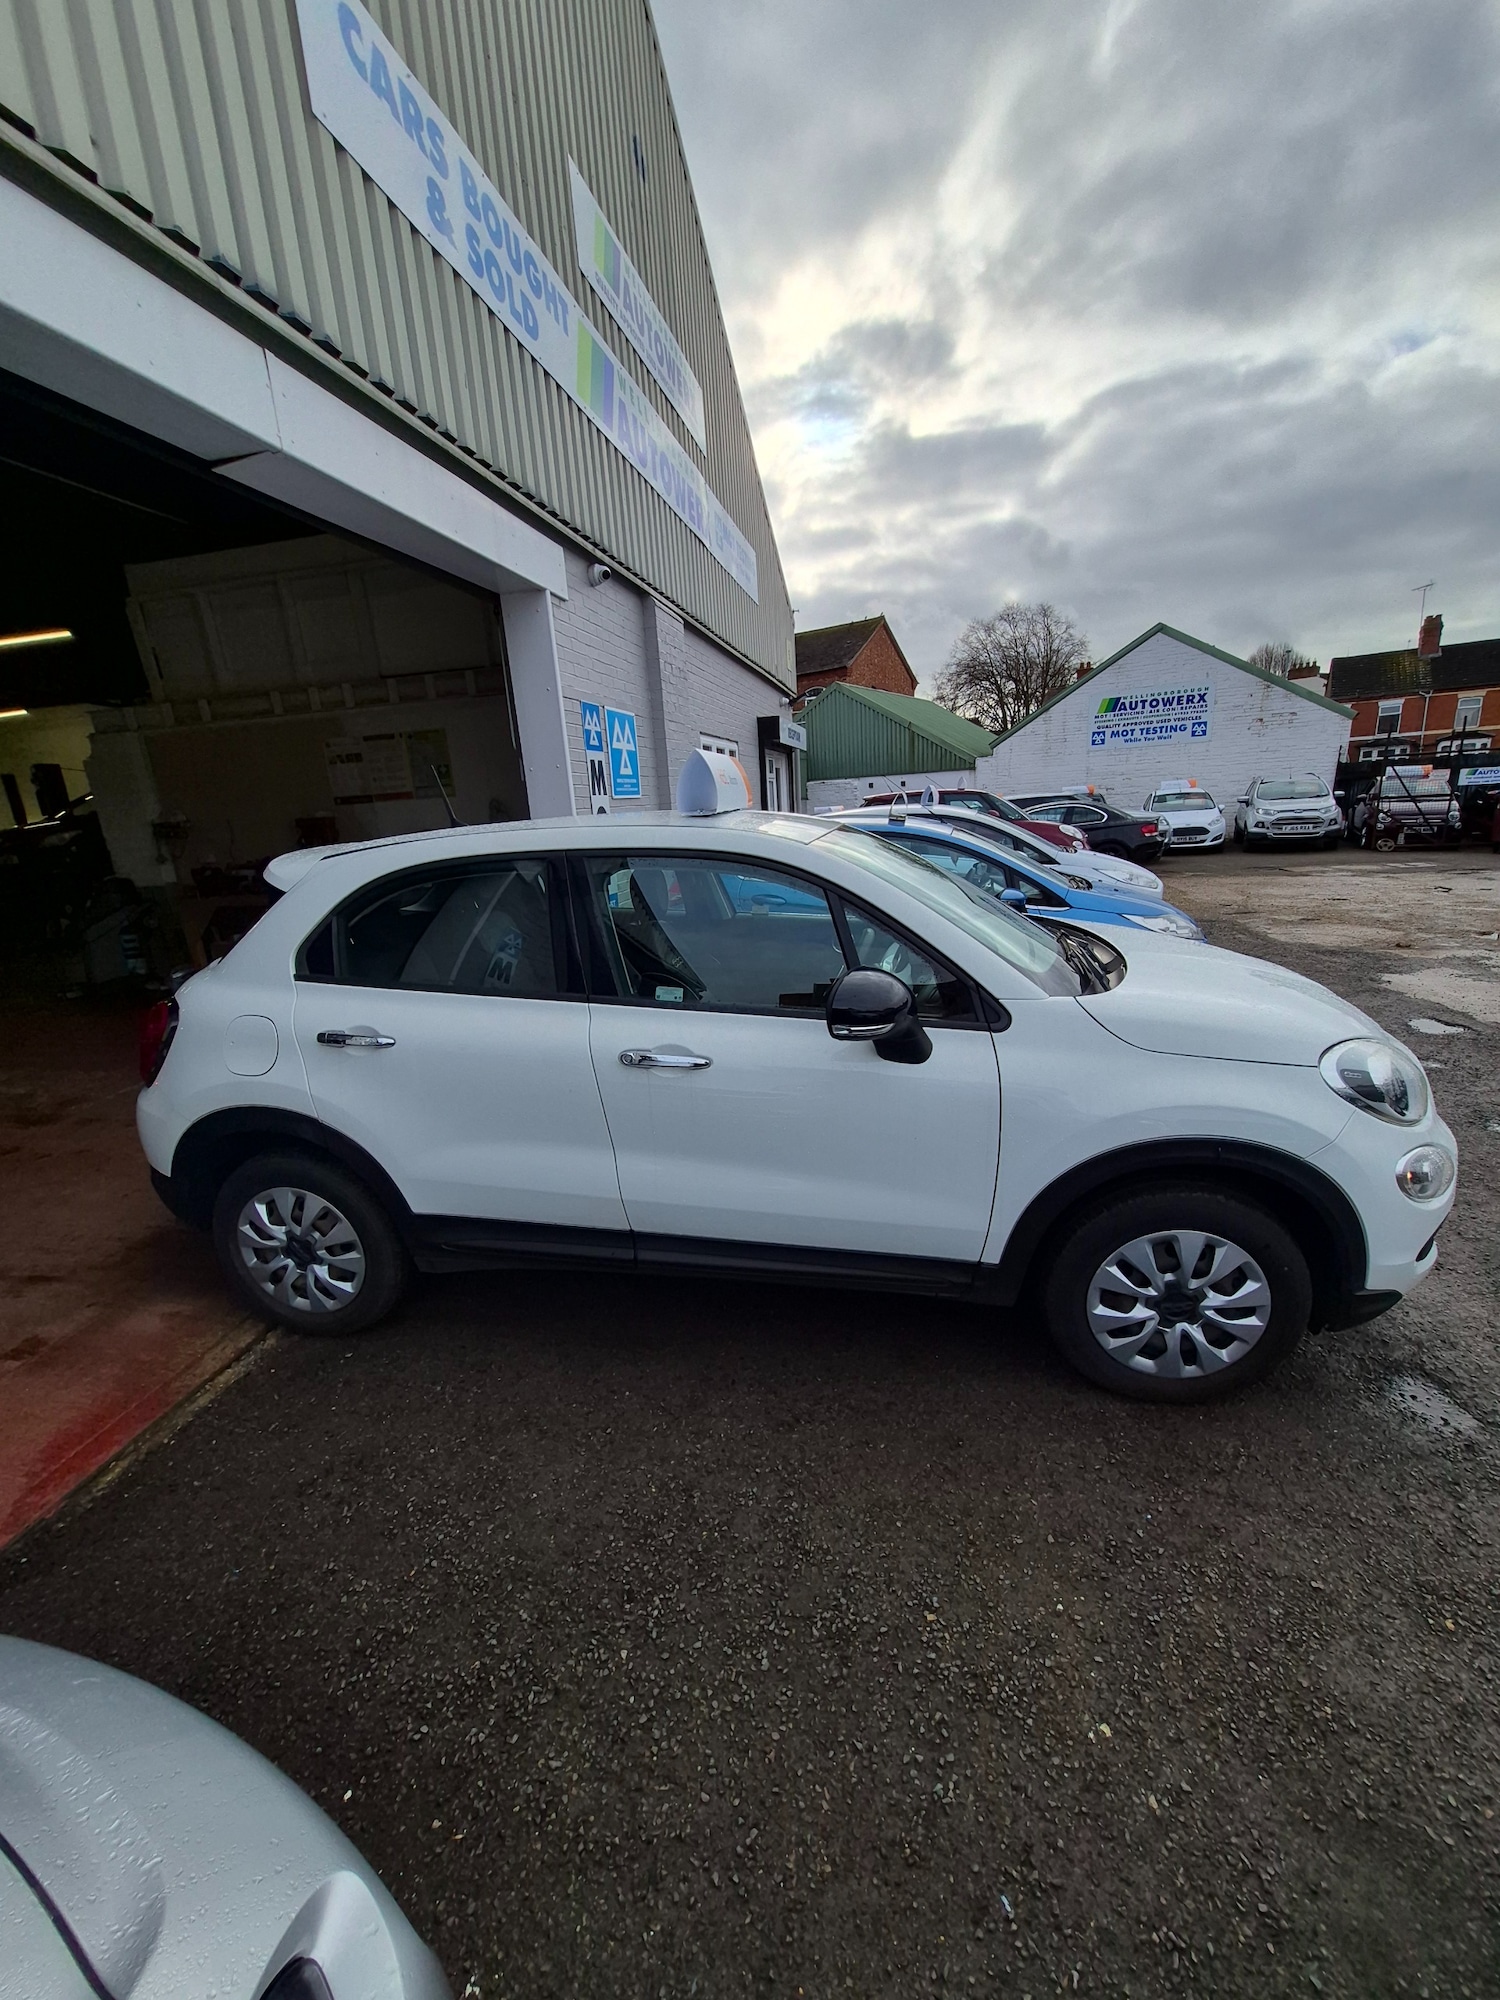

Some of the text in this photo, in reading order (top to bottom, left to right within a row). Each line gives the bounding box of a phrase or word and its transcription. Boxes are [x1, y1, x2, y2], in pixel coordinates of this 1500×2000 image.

[337, 1, 569, 337] CARS BOUGHT
[426, 175, 539, 342] & SOLD
[1123, 686, 1209, 700] WELLINGBOROUGH
[1117, 692, 1208, 712] AUTOWERX
[1180, 703, 1208, 711] REPAIRS
[1110, 723, 1188, 739] MOT TESTING
[1477, 769, 1500, 780] AUTO
